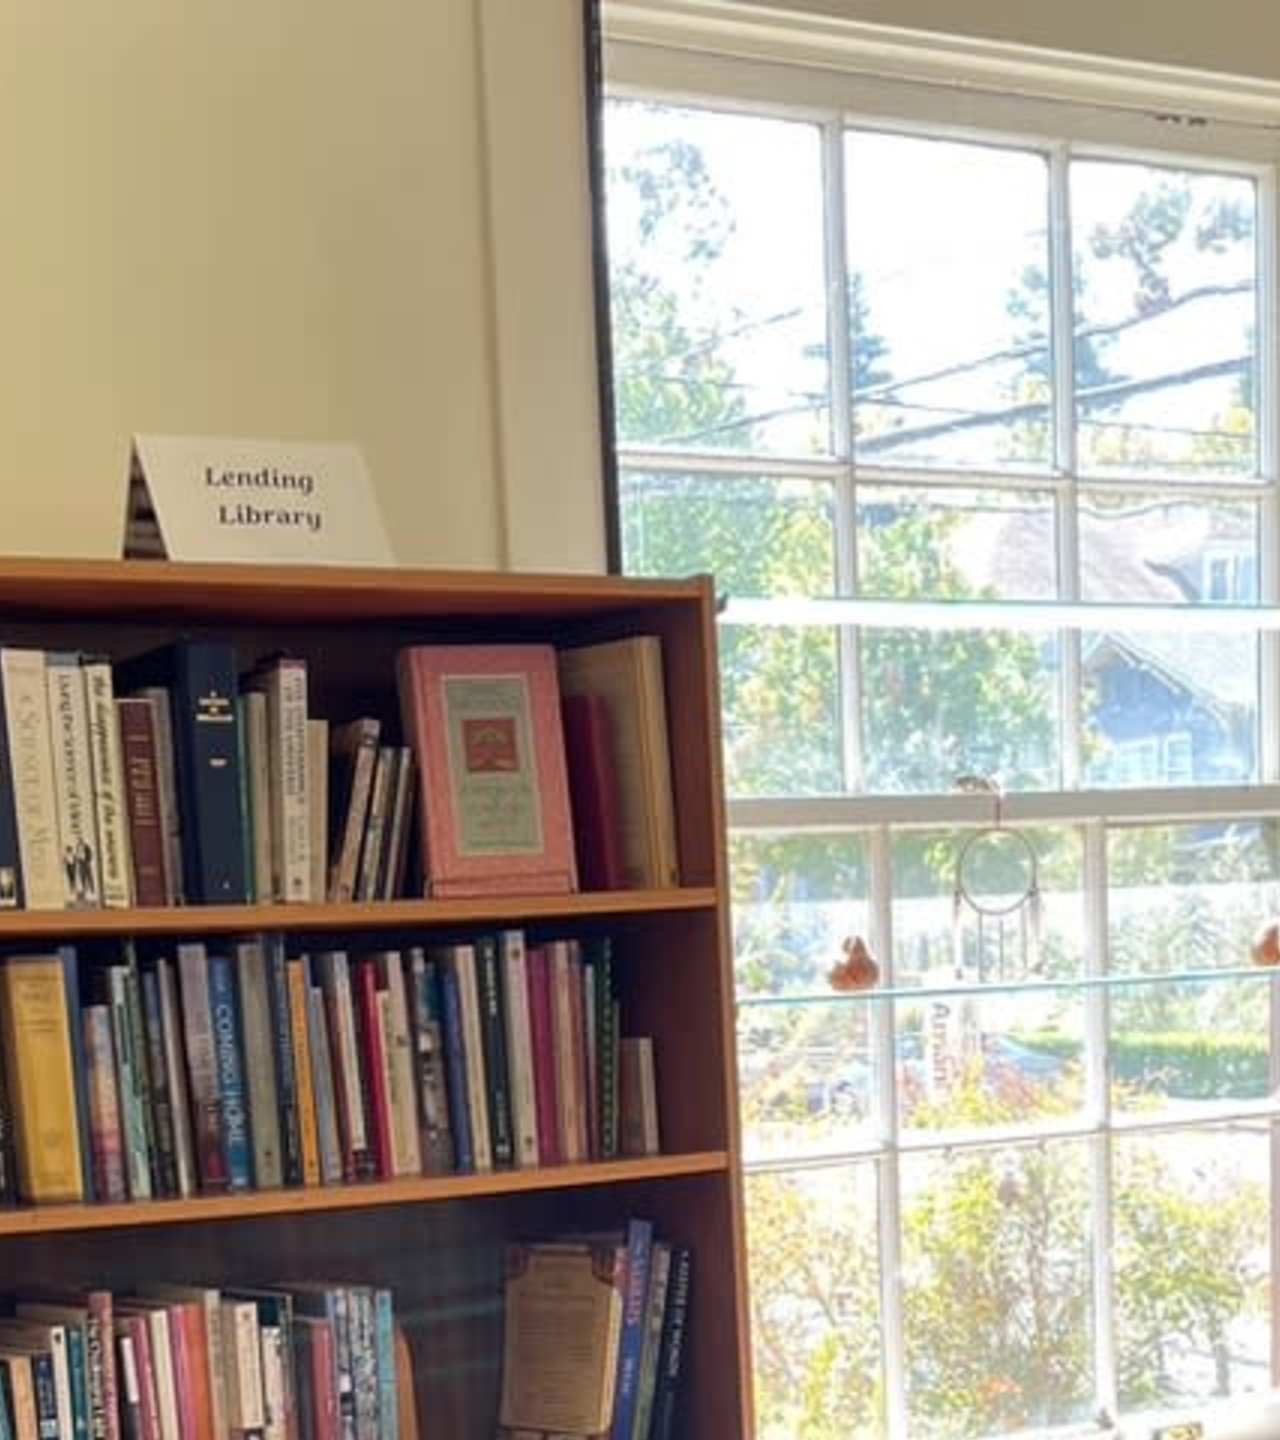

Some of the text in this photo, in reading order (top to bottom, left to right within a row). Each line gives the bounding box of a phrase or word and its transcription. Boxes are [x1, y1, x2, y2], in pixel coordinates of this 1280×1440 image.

[205, 466, 314, 494] Lending
[219, 505, 321, 532] Library
[216, 1003, 238, 1086] COMING
